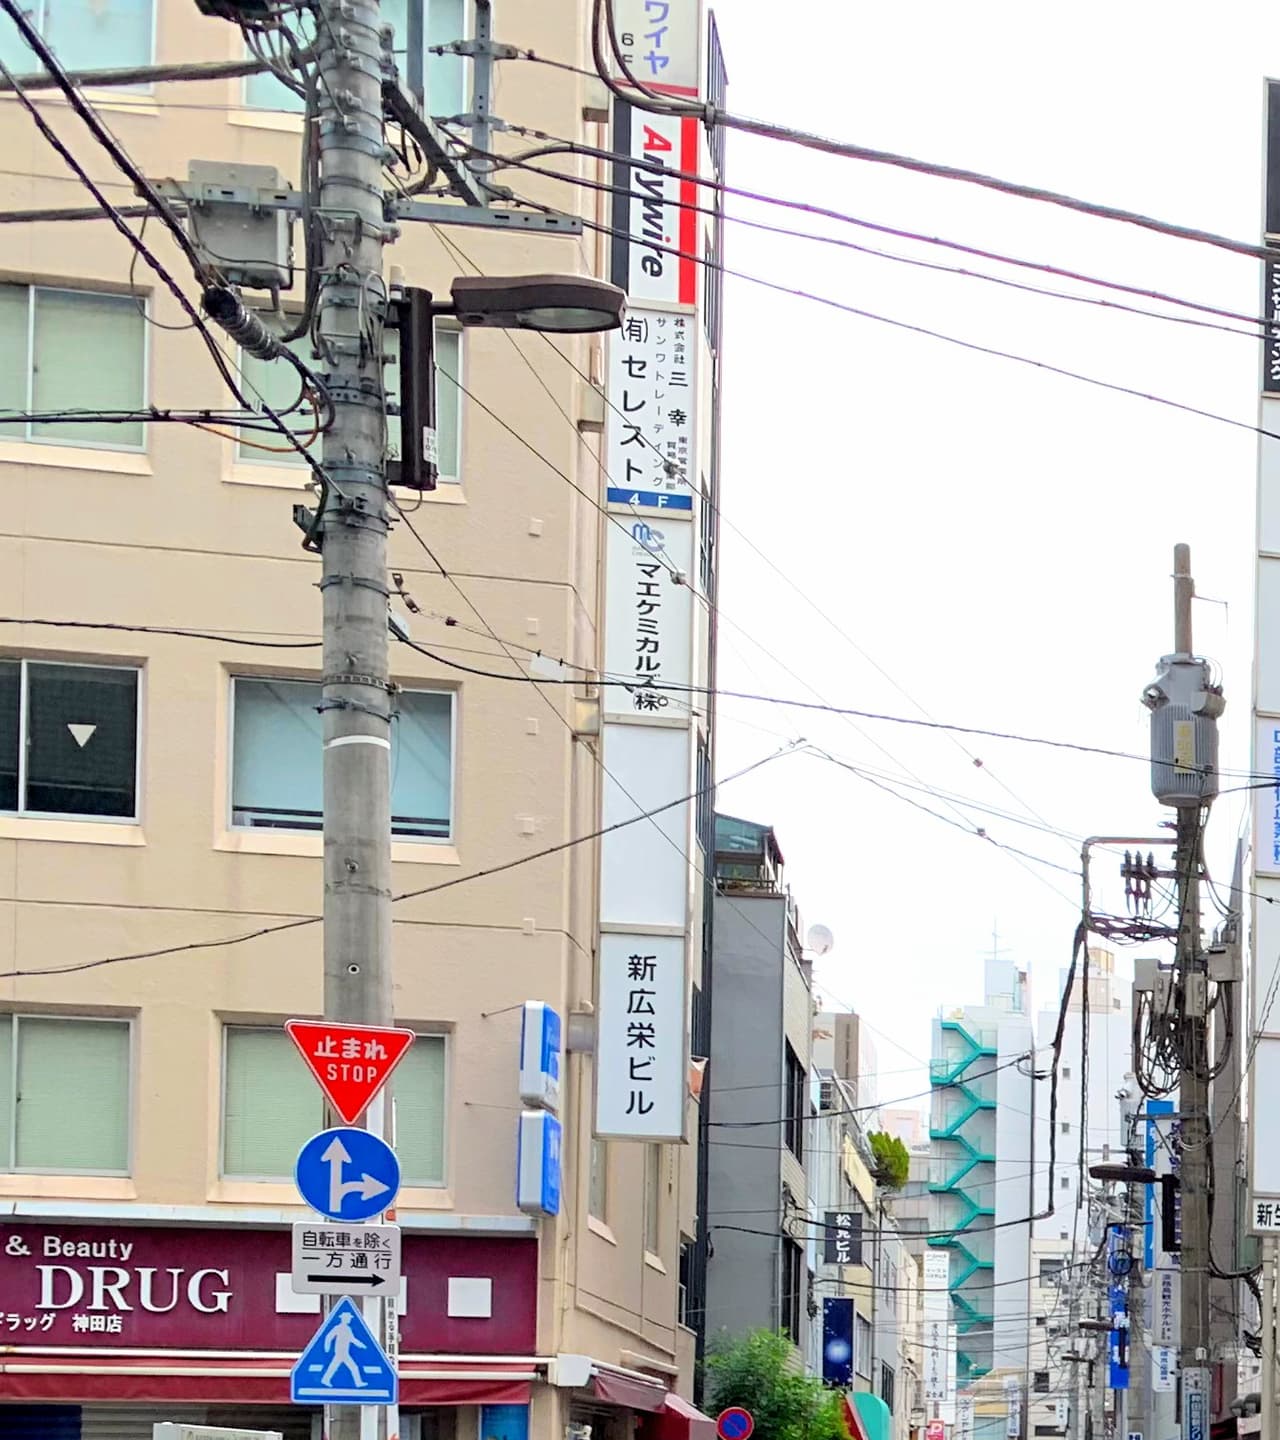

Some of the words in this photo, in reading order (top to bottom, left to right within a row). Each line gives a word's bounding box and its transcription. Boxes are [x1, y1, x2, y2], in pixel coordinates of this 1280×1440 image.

[635, 125, 672, 278] Anywire
[314, 1035, 388, 1061] 止まれ
[626, 954, 657, 1116] 新広栄ビル
[327, 1063, 378, 1083] STOP
[5, 1235, 32, 1256] &
[43, 1235, 133, 1261] Beauty
[302, 1230, 392, 1250] 自転車を除く
[302, 1251, 392, 1271] 一方通行
[35, 1264, 233, 1314] DRUG
[0, 1312, 56, 1332] ラッグ
[72, 1313, 123, 1333] 神田店
